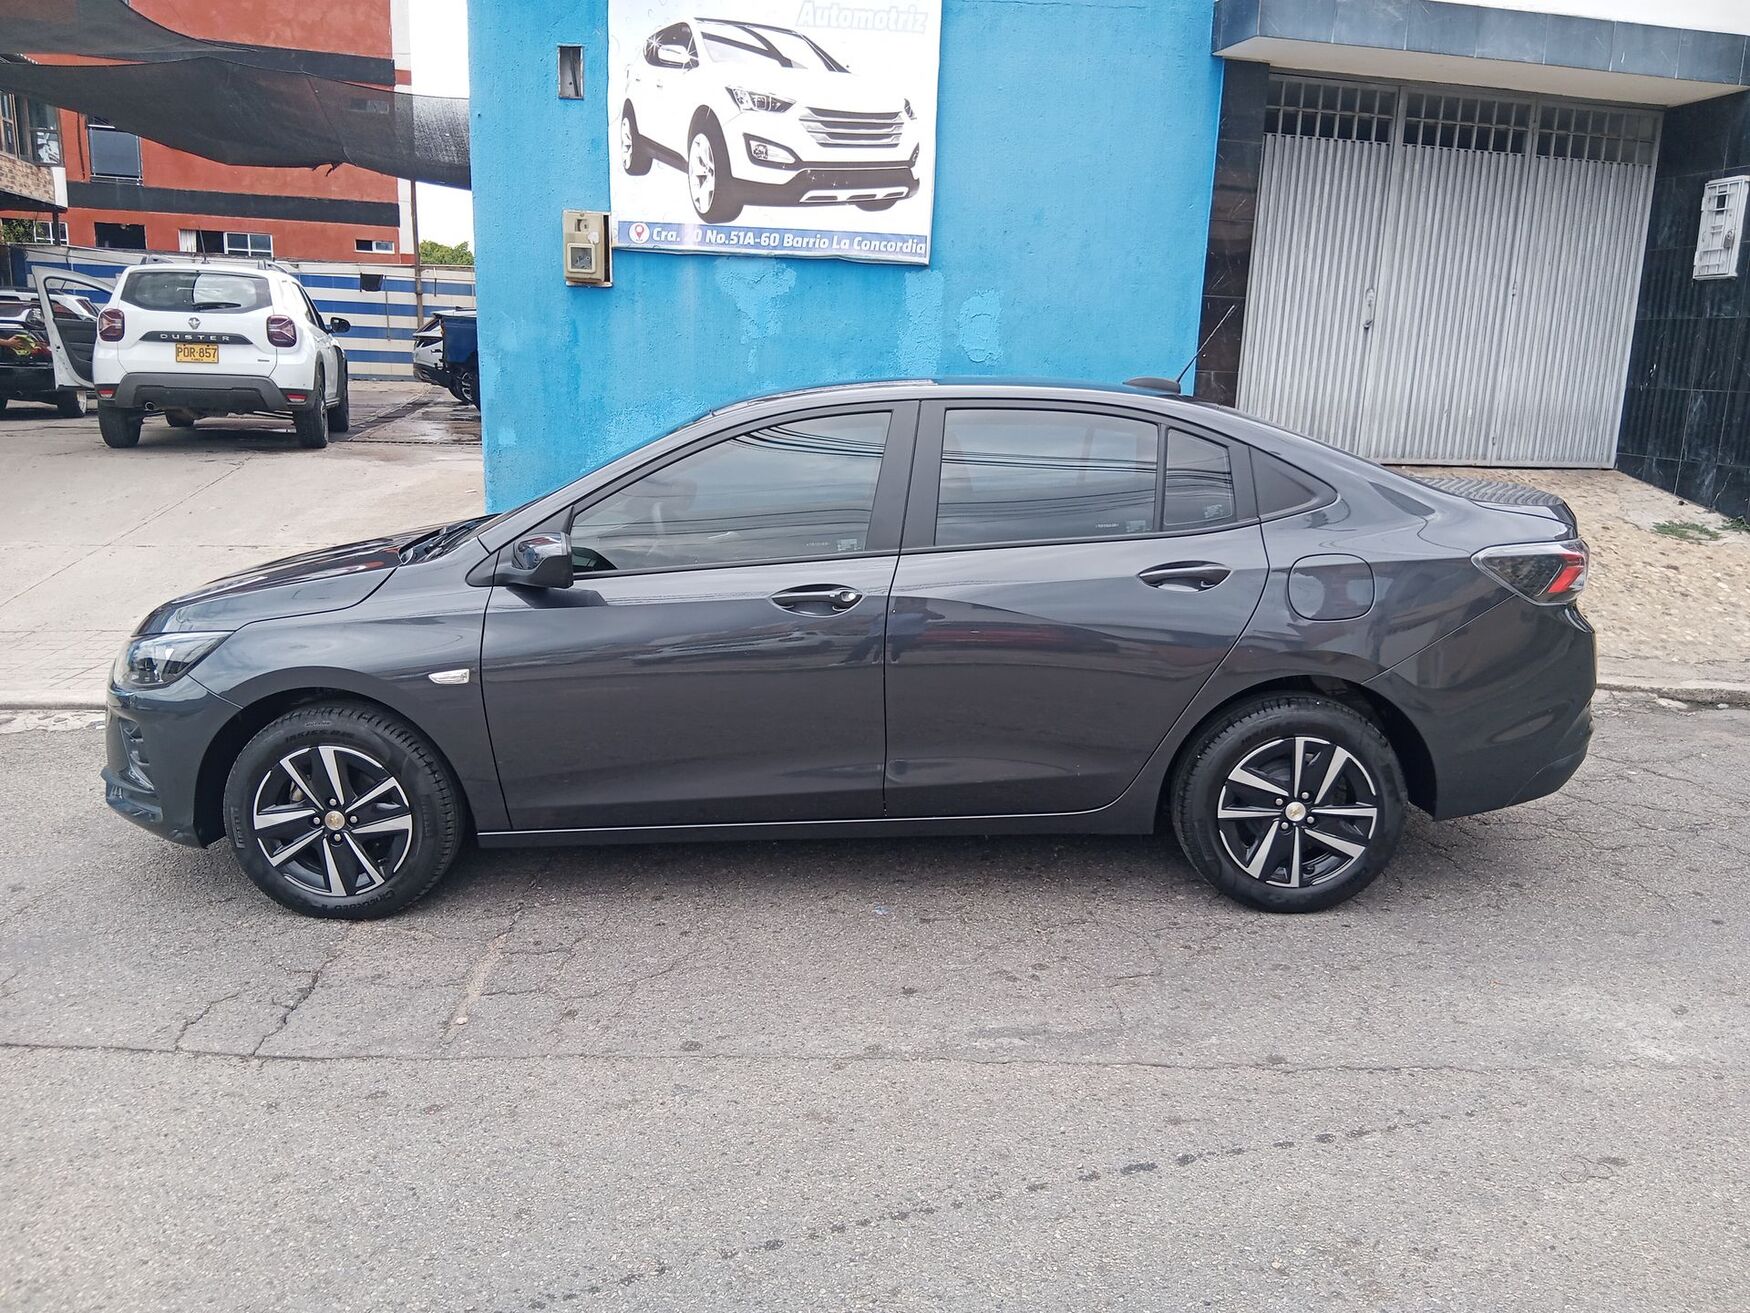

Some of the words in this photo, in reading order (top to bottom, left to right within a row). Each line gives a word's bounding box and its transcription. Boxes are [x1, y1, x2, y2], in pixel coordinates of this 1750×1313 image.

[796, 0, 928, 33] Automotriz
[653, 228, 681, 242] Cra.
[705, 229, 780, 247] No.51A-60
[783, 233, 829, 248] Barrio
[831, 235, 850, 250] La
[853, 236, 927, 254] Concordia
[160, 333, 230, 341] DUSTER
